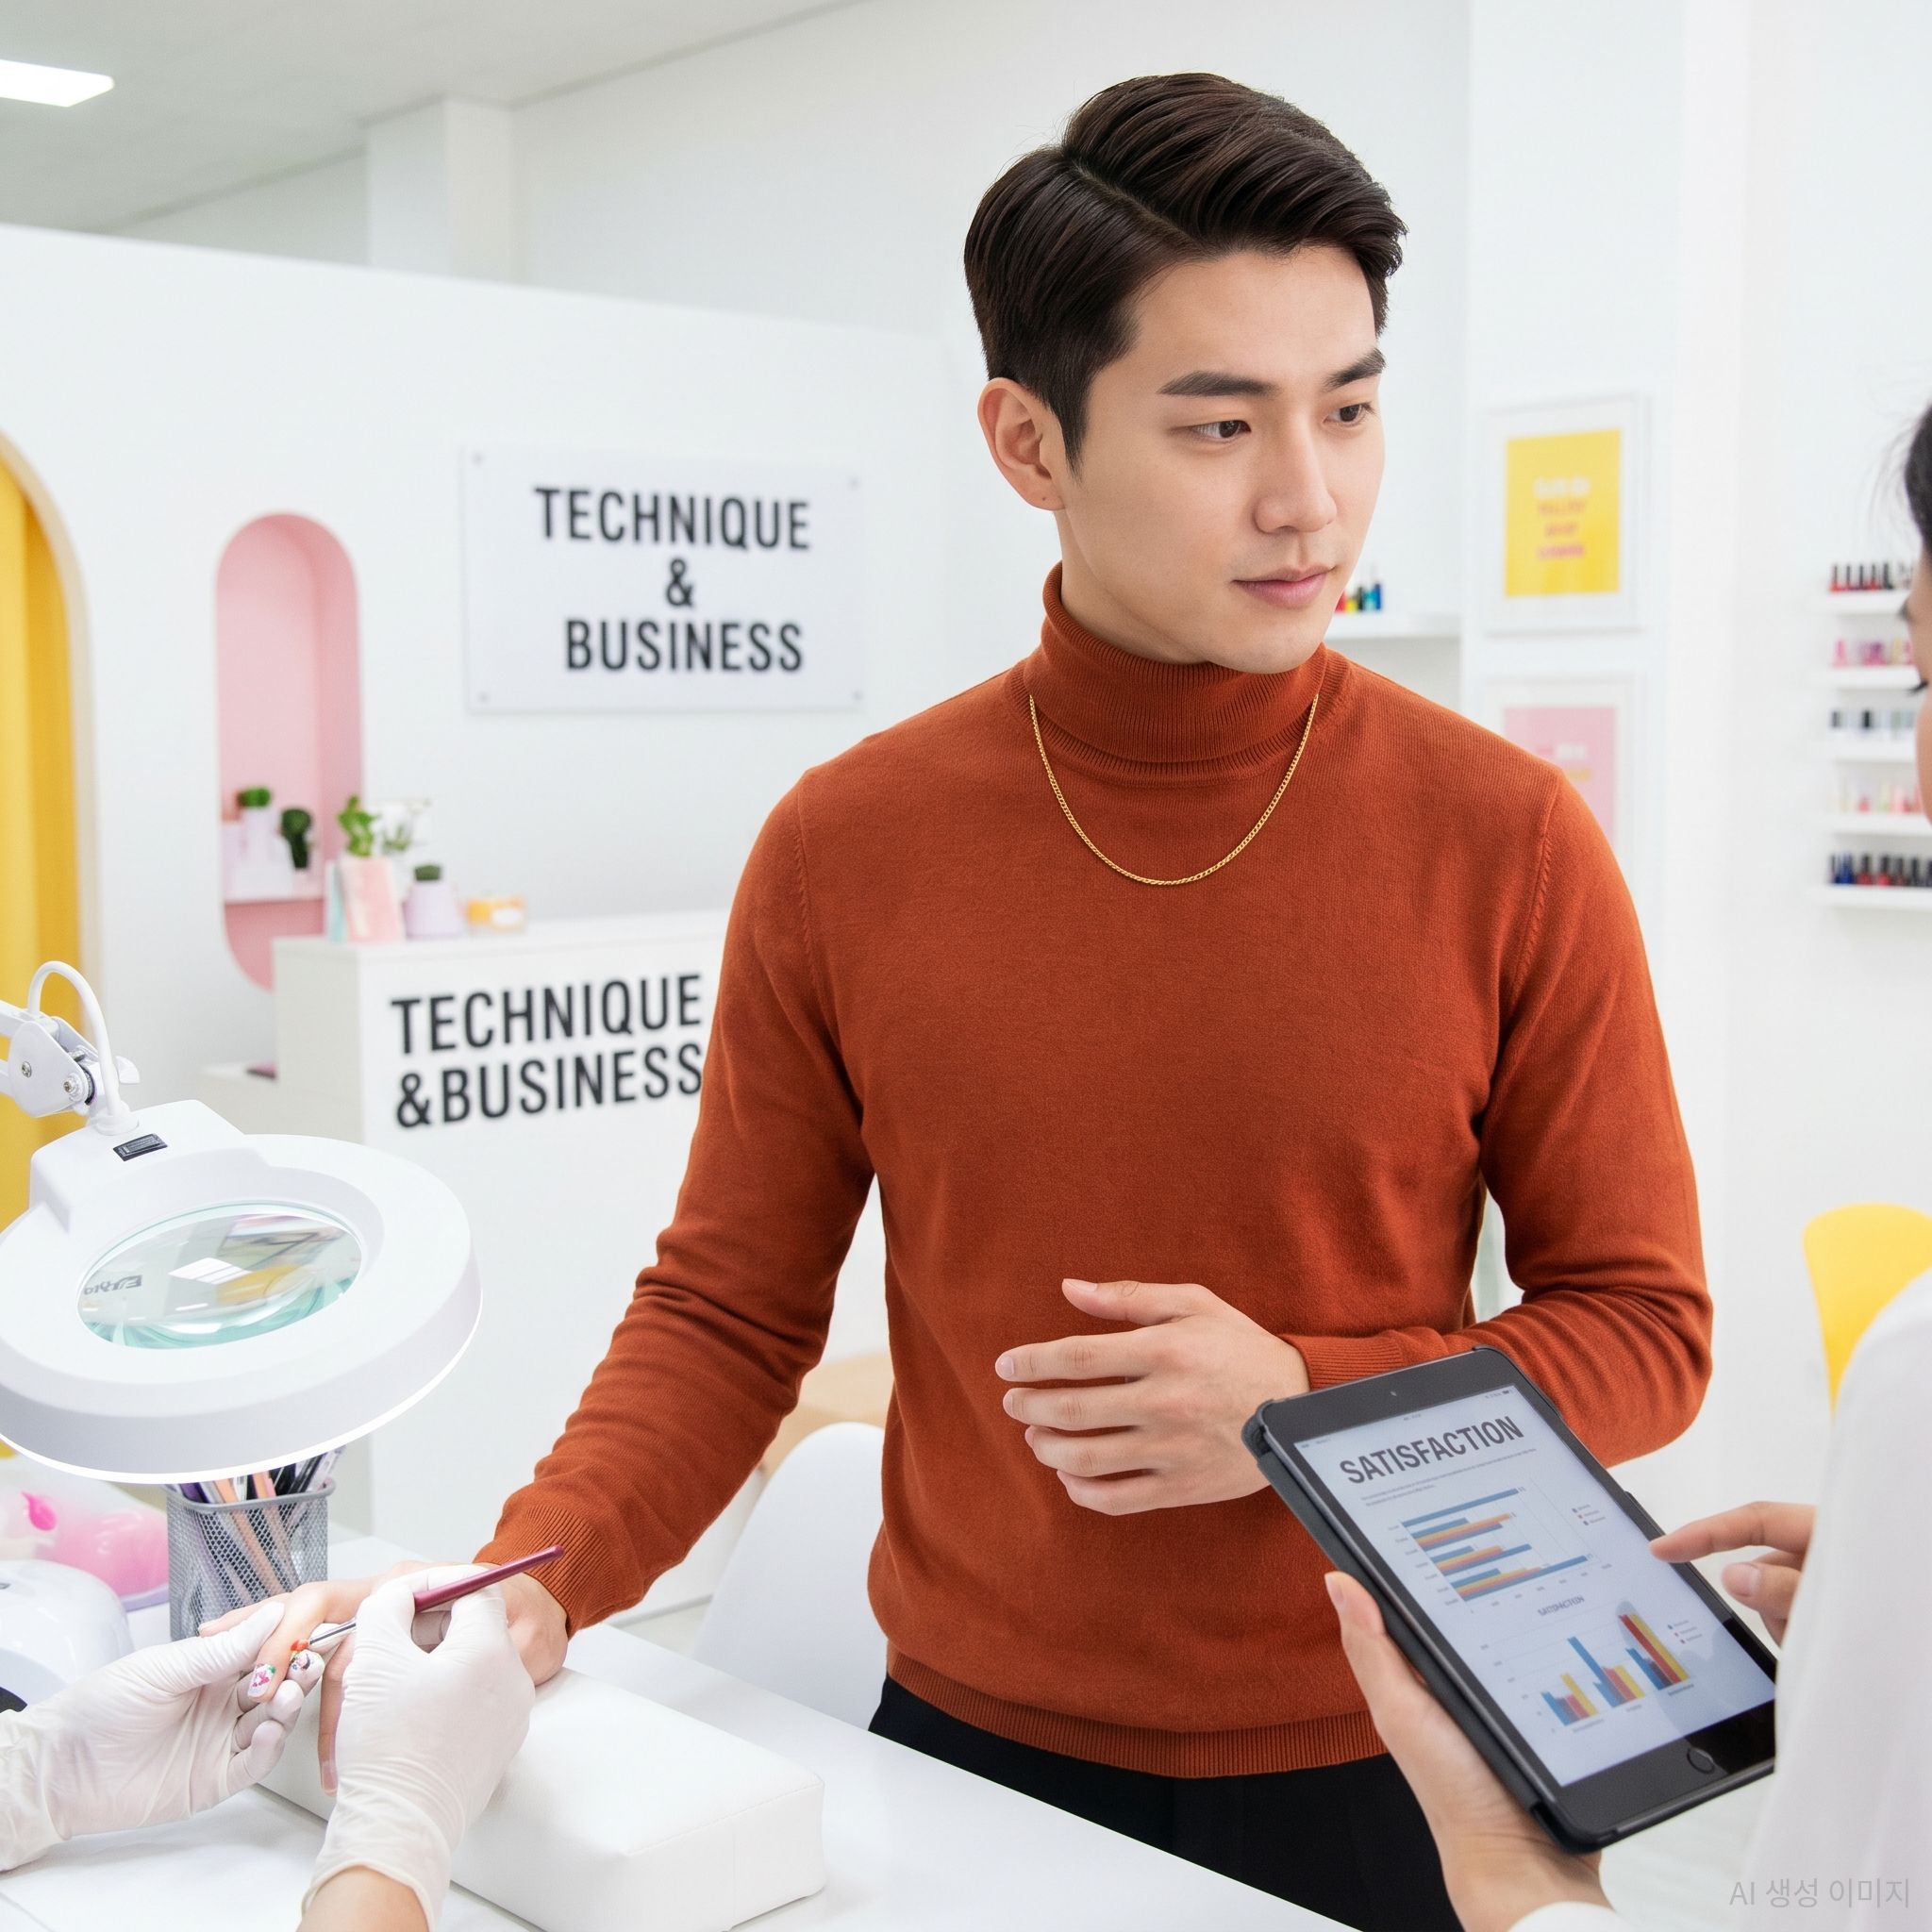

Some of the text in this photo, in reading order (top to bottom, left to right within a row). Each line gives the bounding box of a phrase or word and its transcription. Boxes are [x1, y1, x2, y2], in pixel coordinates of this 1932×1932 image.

[534, 487, 808, 550] TECHNIQUE
[665, 558, 694, 608] &
[566, 619, 802, 672] BUSINESS
[391, 974, 701, 1055] TECHNIQUE
[396, 1043, 702, 1128] &BUSINESS
[1340, 1415, 1524, 1484] SATISFACTION
